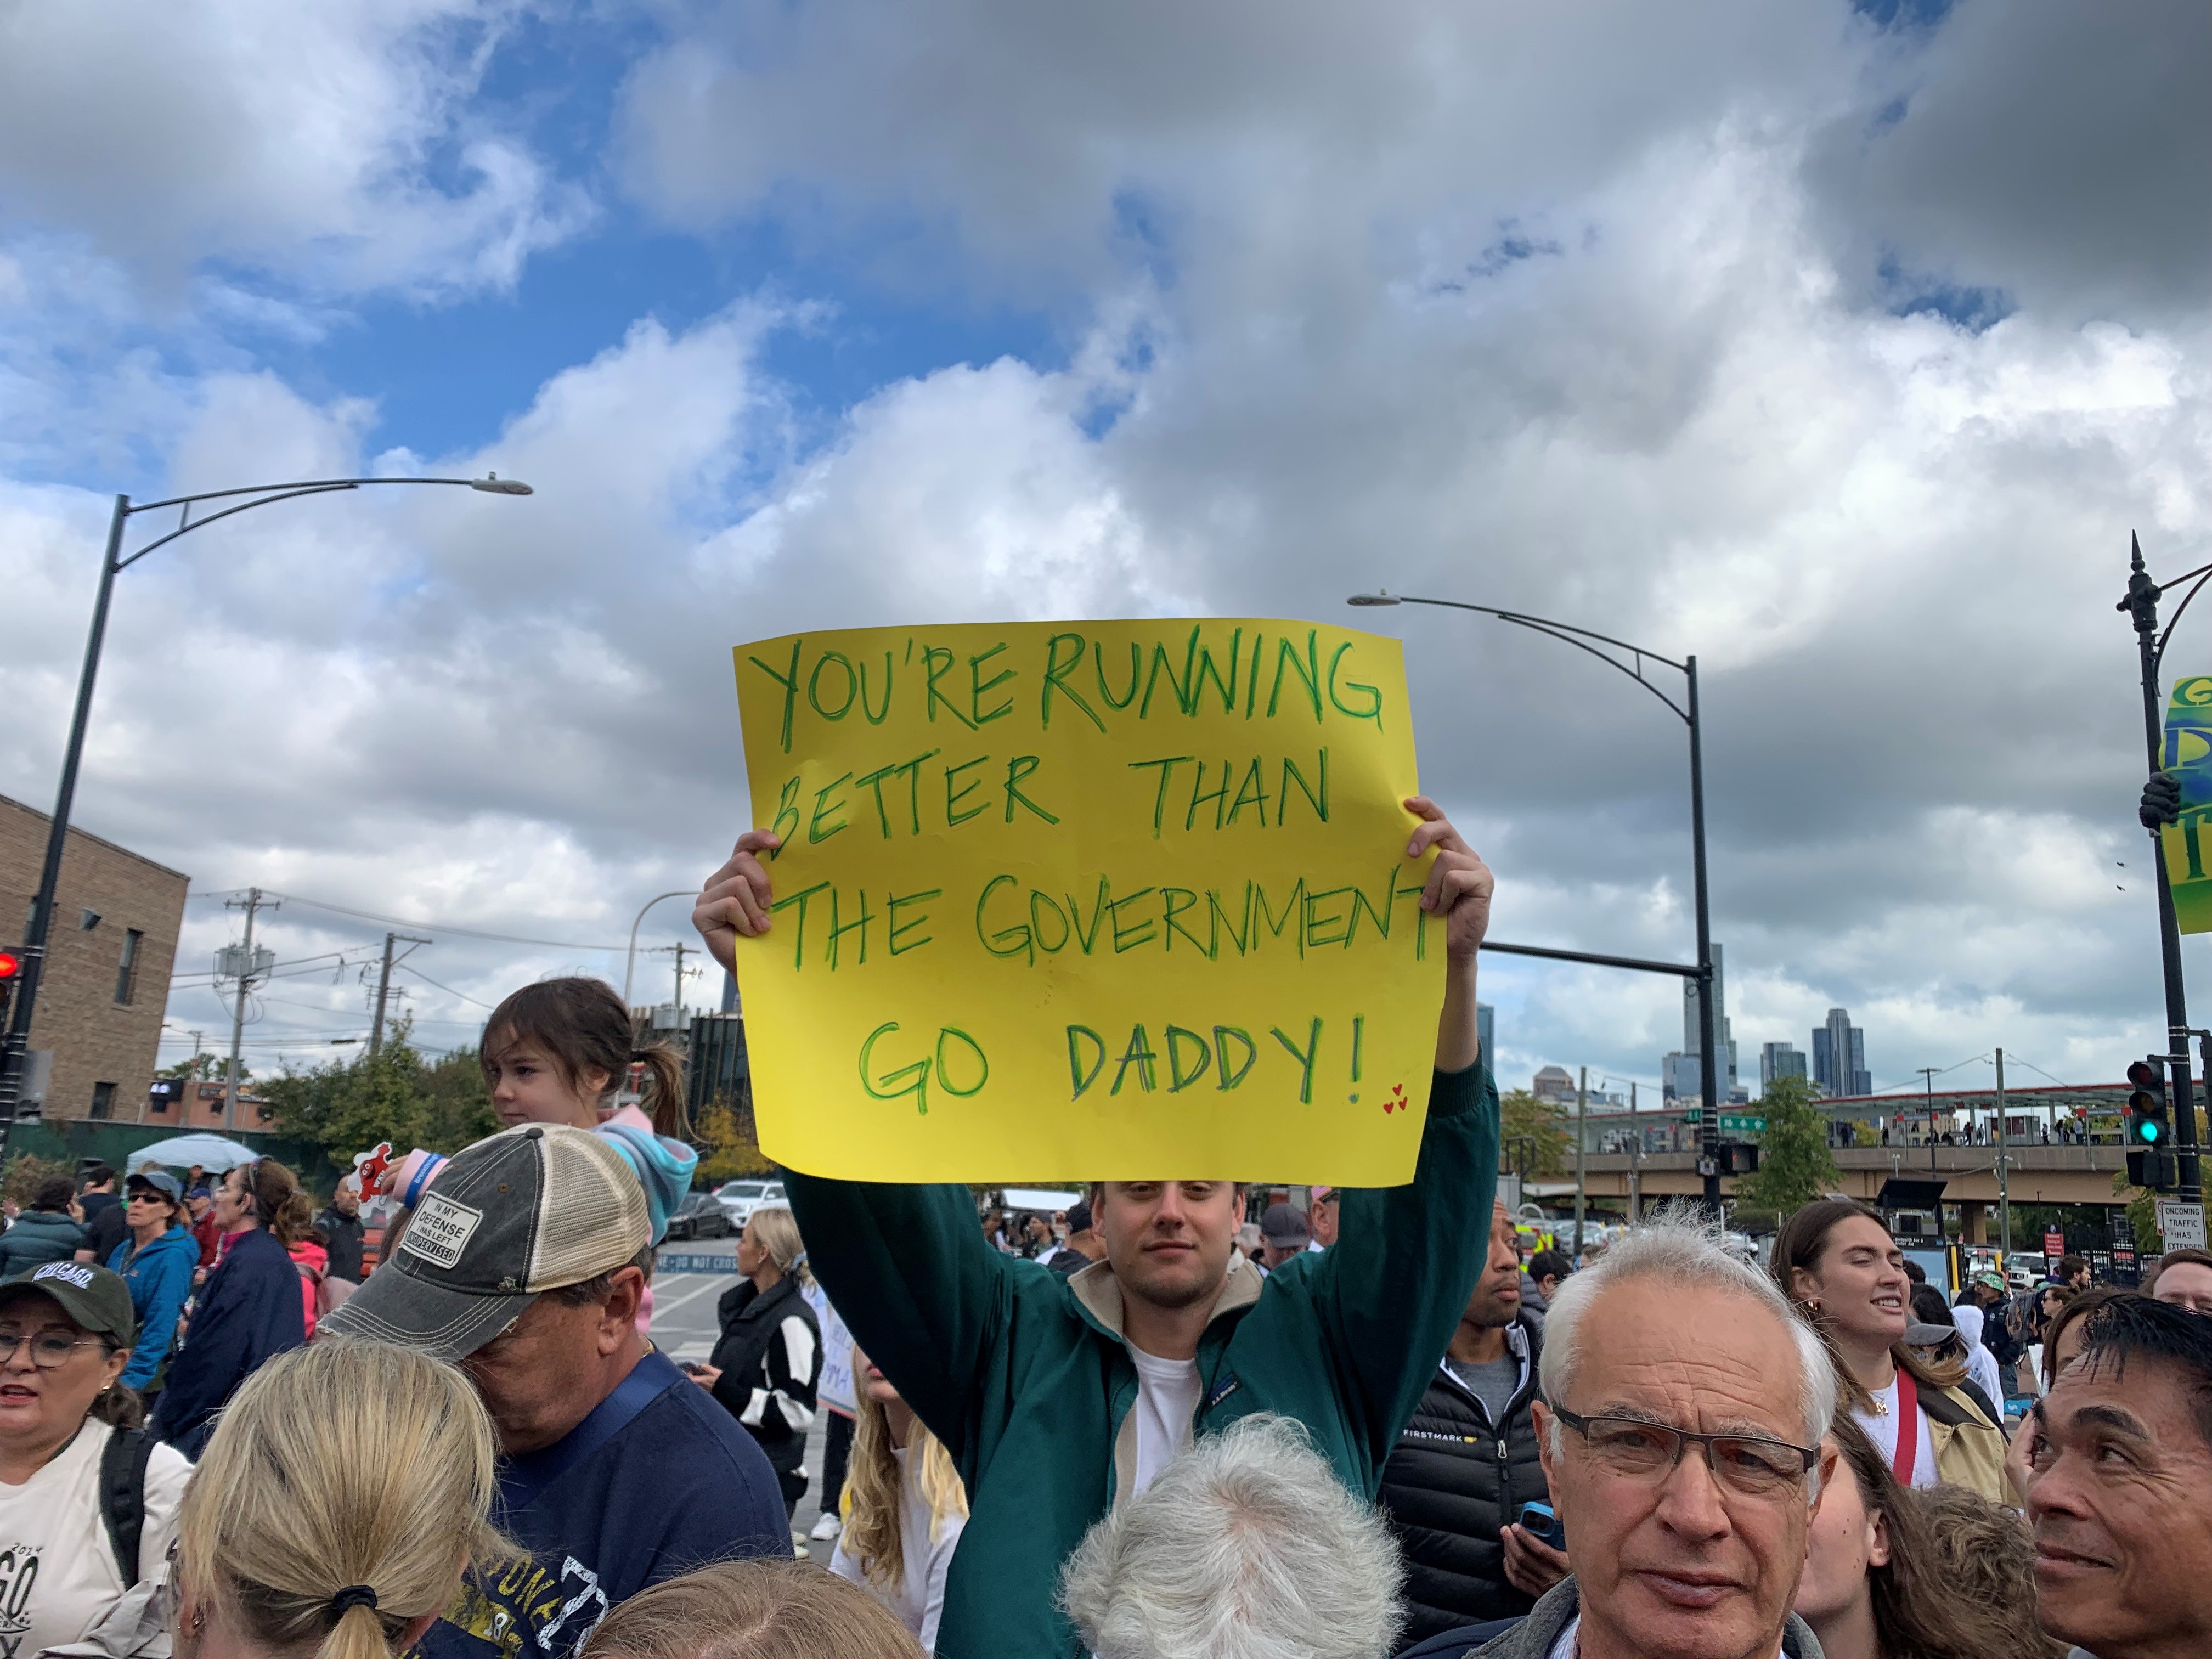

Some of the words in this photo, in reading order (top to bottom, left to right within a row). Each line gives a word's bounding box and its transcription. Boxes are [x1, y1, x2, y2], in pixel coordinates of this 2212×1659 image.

[749, 637, 1015, 754] YOU'RE
[1042, 625, 1384, 734] RUNNING
[772, 748, 1059, 860] BETTER
[1128, 747, 1328, 838] THAN
[770, 882, 943, 972] THE
[977, 865, 1428, 967] GOVERNMENT
[859, 1021, 989, 1115] GO
[1068, 1014, 1363, 1105] DADDY!
[434, 1203, 443, 1212] IN
[442, 1206, 459, 1218] MY
[2165, 1207, 2199, 1216] ONCOMING
[419, 1211, 465, 1239] DEFENSE
[2169, 1218, 2198, 1227] TRAFFIC
[407, 1233, 454, 1260] UNSUPERVISED
[420, 1226, 432, 1237] WAS
[431, 1232, 452, 1245] LEFT
[2176, 1231, 2192, 1239] HAS
[32, 1262, 94, 1285] CHICAGO
[1403, 1429, 1463, 1443] FIRSTMARK
